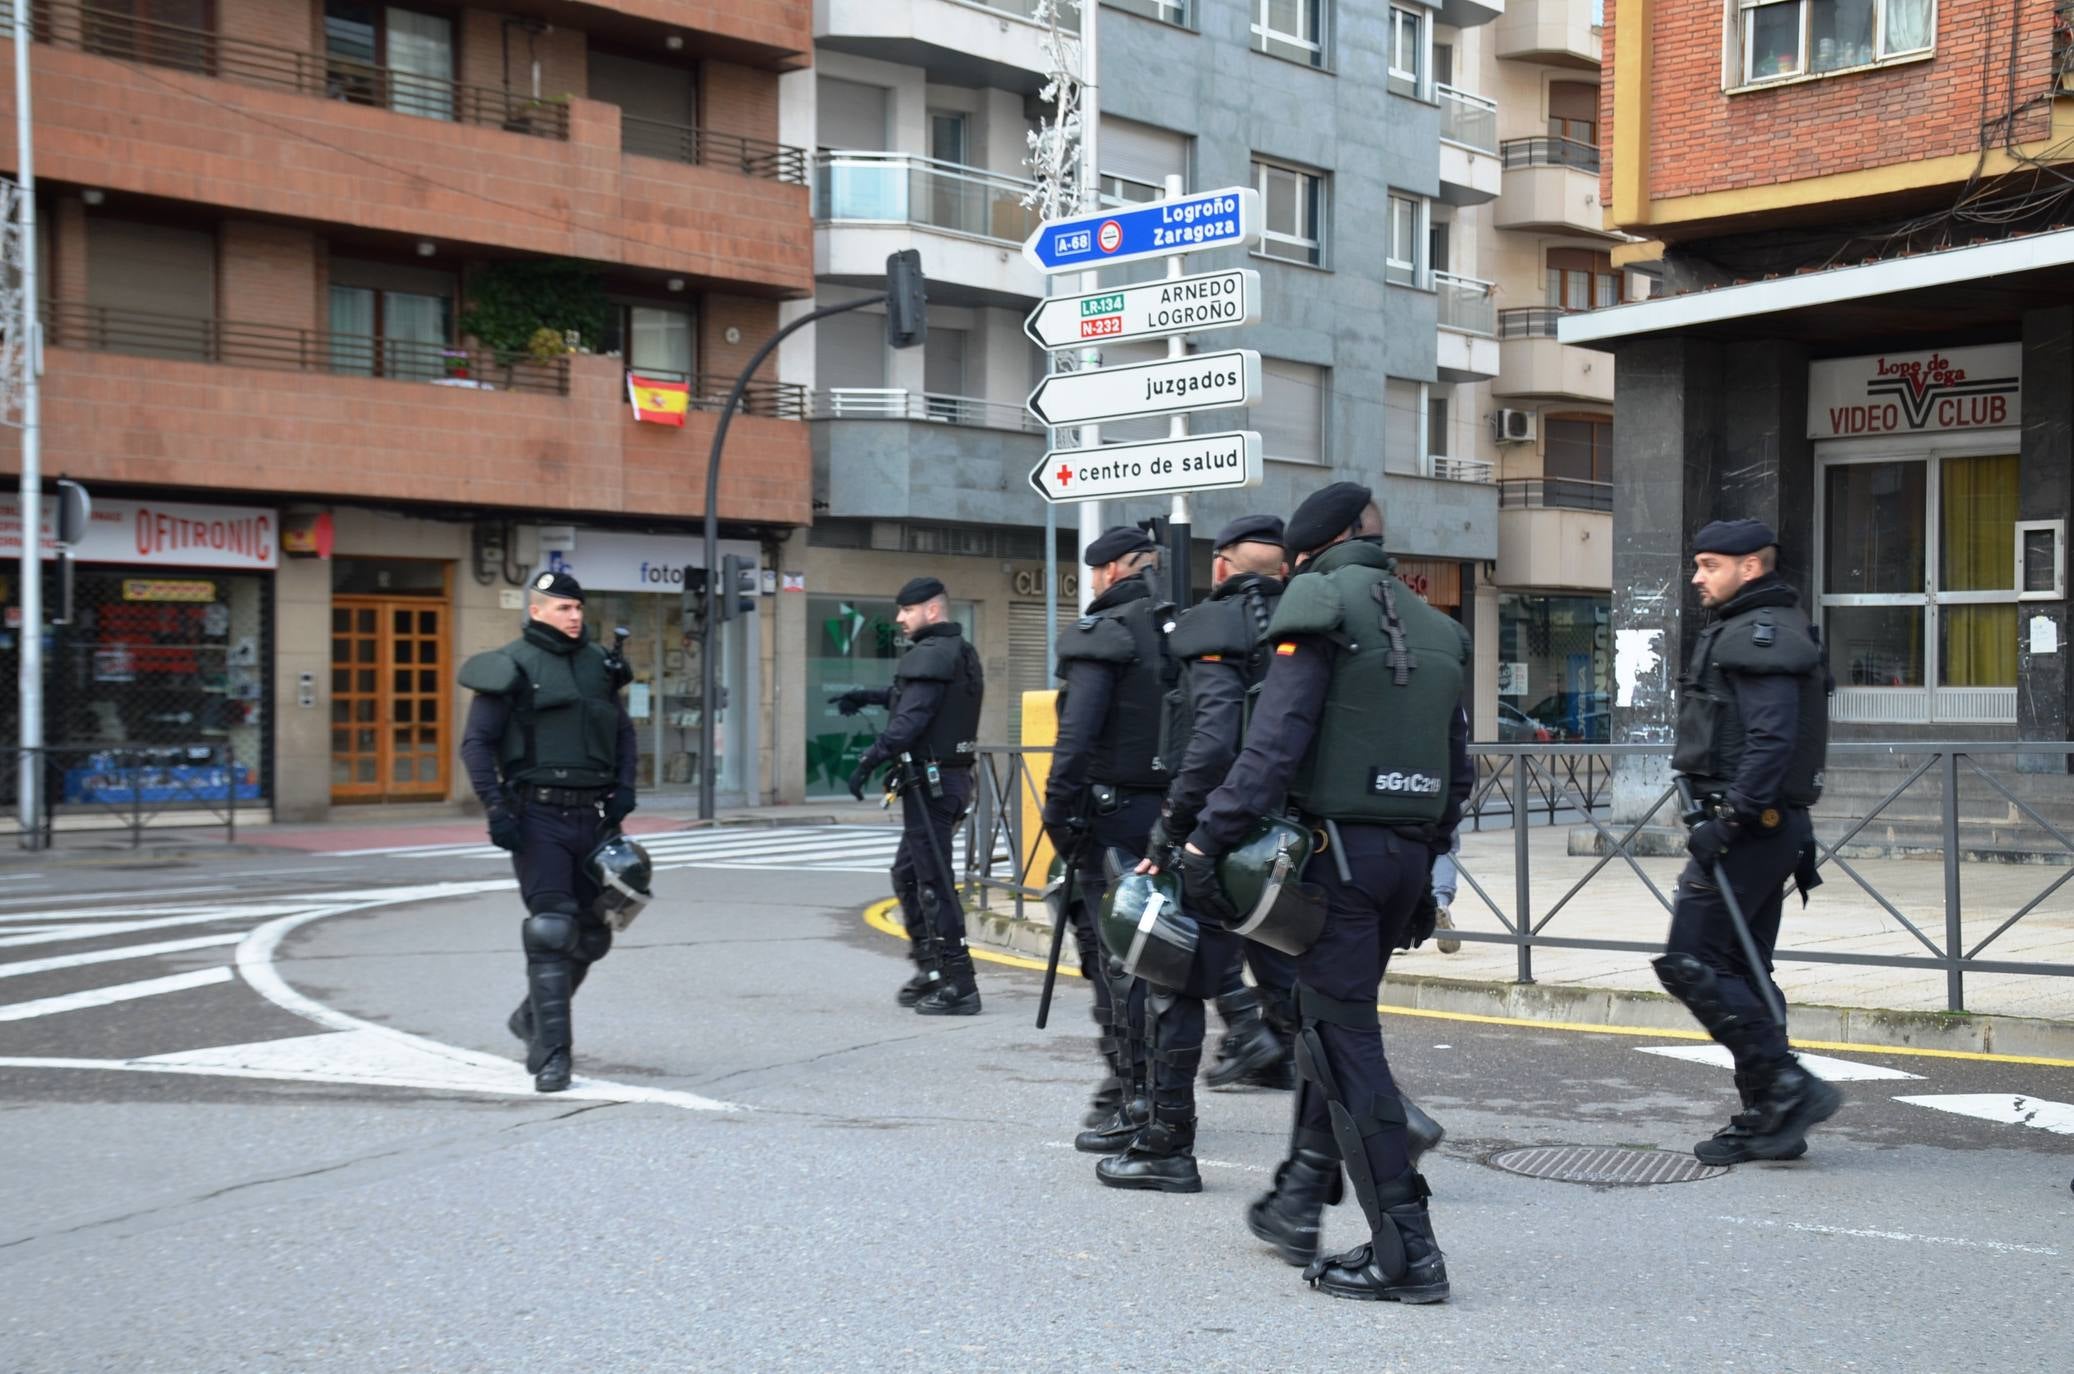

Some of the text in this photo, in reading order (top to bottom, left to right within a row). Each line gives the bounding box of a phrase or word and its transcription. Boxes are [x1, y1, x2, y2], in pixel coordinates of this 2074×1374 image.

[1162, 197, 1235, 224] Logroño
[1058, 235, 1088, 252] A-68
[1153, 220, 1235, 247] Zaragoza
[1161, 278, 1236, 304] ARNEDO
[1082, 296, 1122, 314] LR-134
[1148, 300, 1236, 328] LOGROÑO
[1082, 319, 1120, 336] N-232
[1877, 352, 1949, 378] Lope de
[1146, 371, 1237, 400] juzgados
[1907, 369, 1966, 400] Vega
[1829, 395, 2007, 434] VIDEO CLUB
[1079, 449, 1238, 481] centro de salud
[136, 508, 271, 561] OFITRONIC
